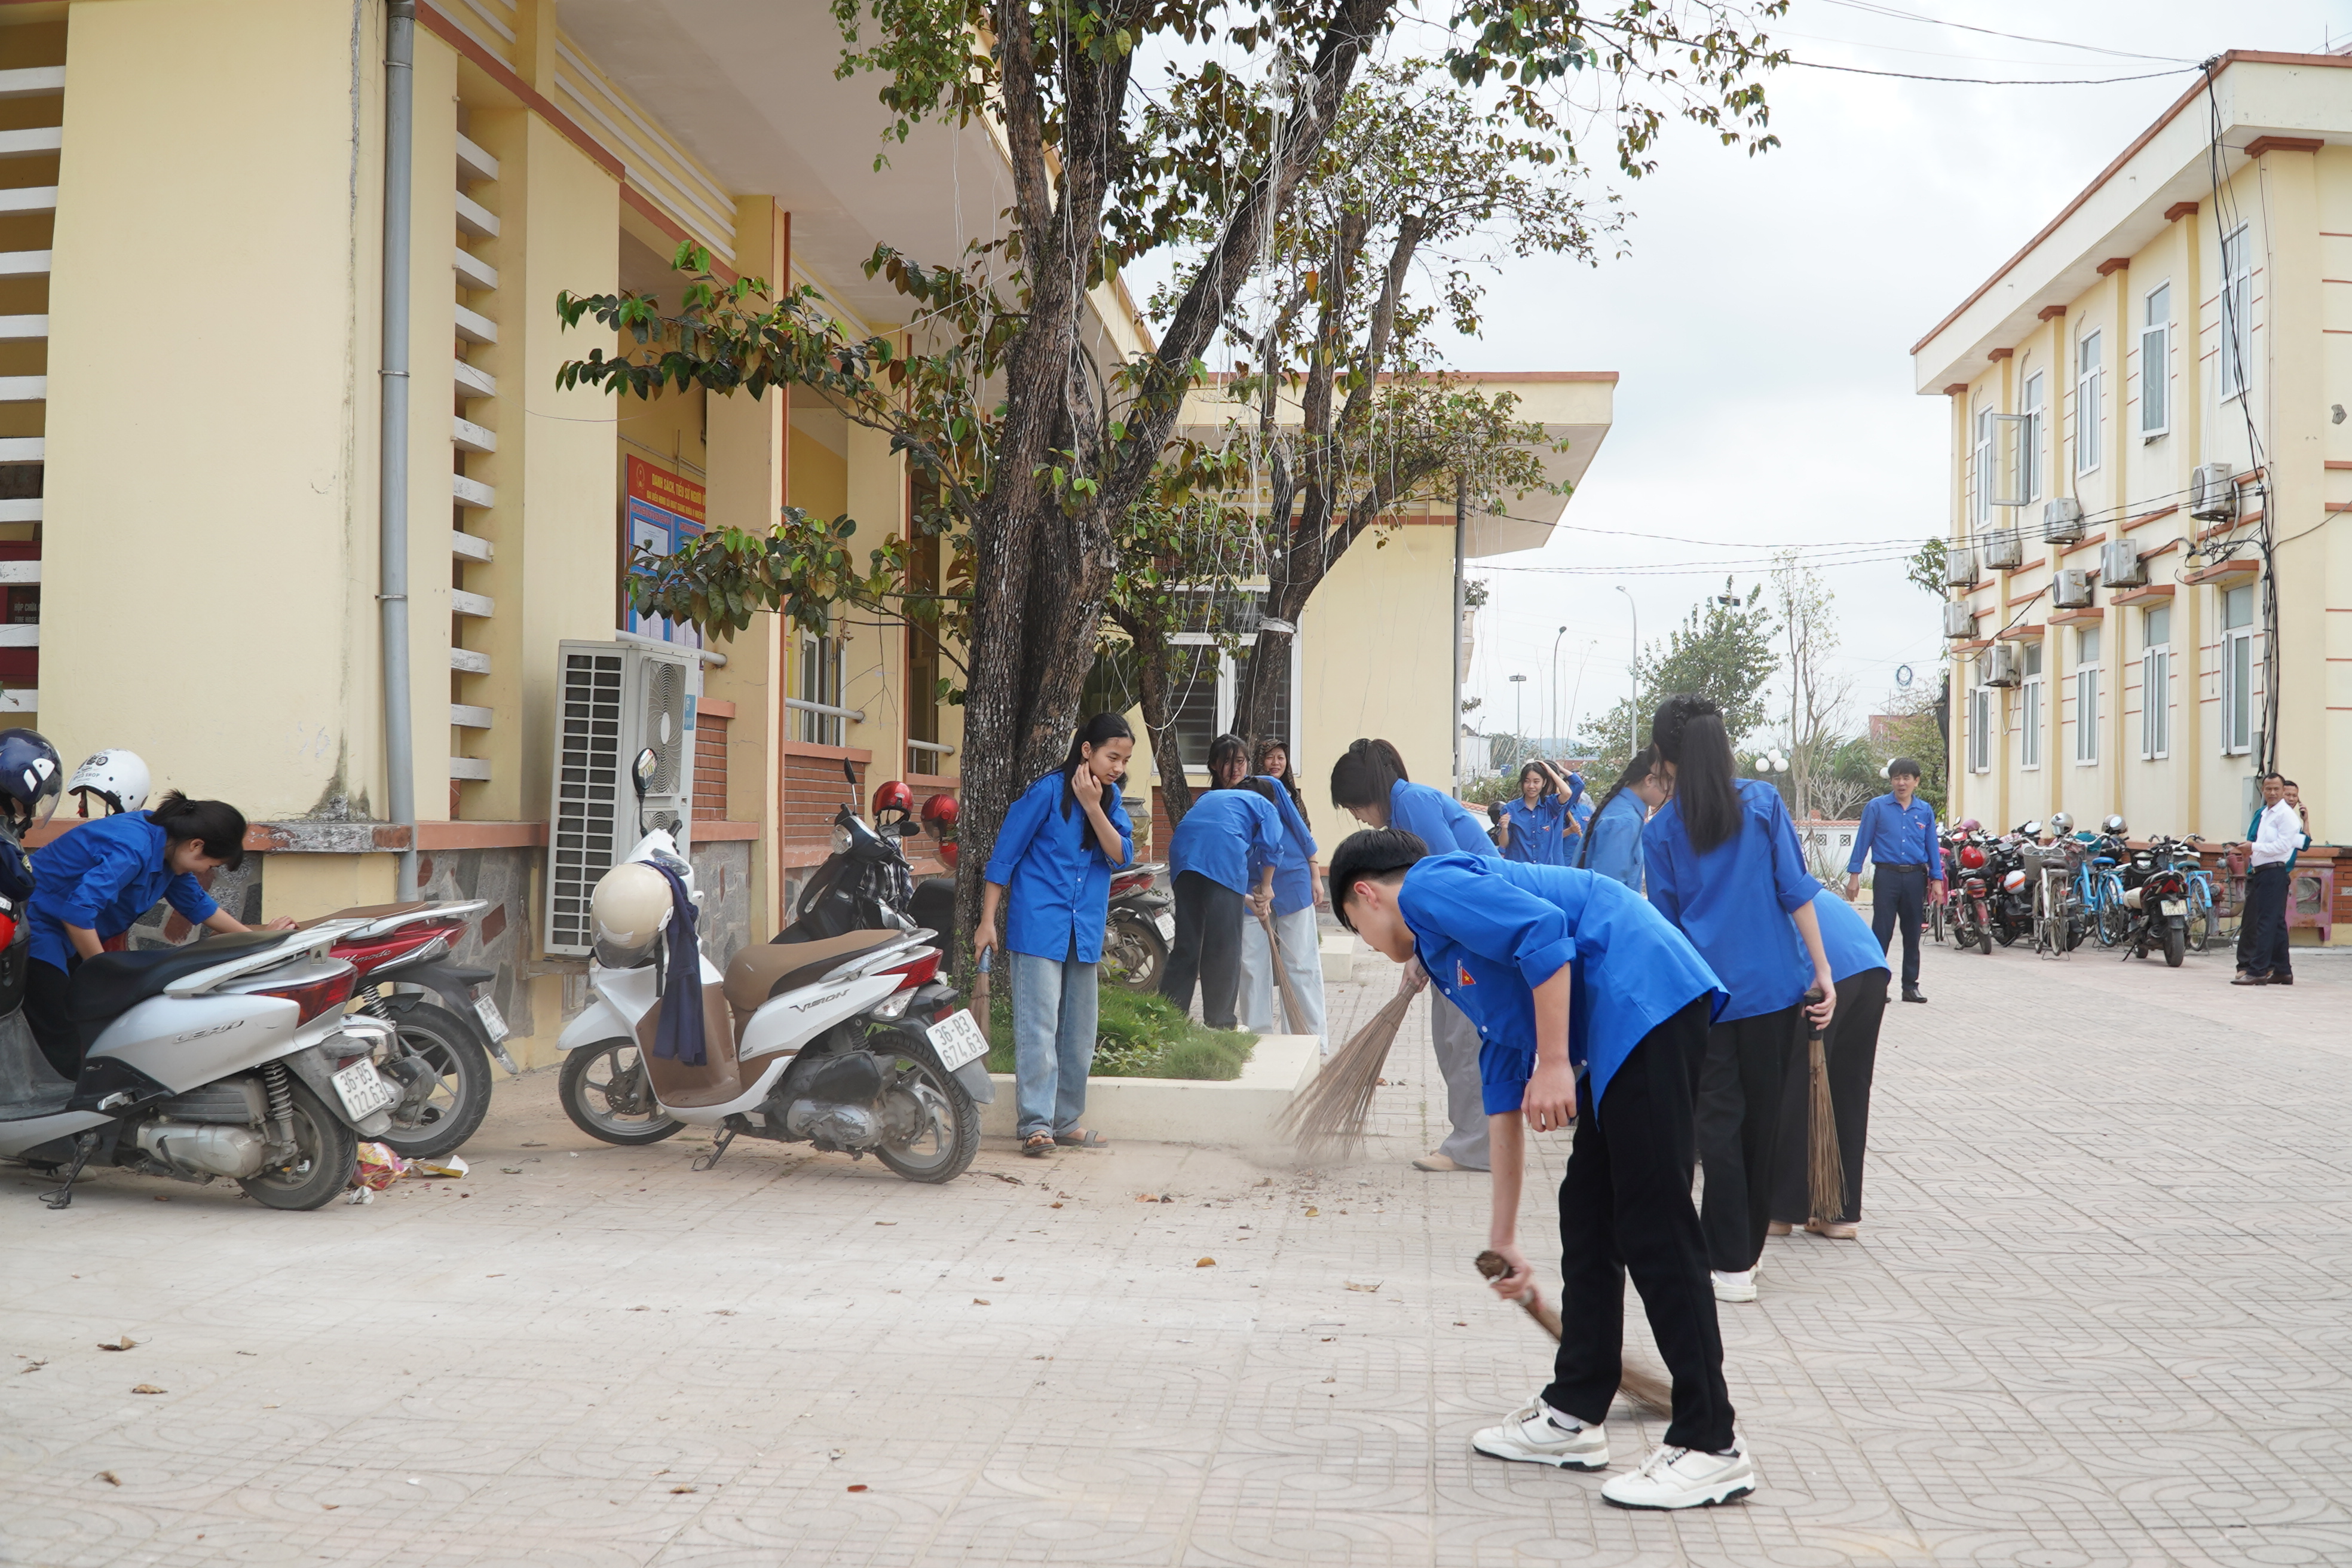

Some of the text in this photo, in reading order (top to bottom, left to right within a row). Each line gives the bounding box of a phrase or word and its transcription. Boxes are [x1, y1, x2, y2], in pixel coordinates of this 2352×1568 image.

[171, 1019, 244, 1045] LEAD
[935, 1015, 970, 1046] 36-B3
[942, 1033, 984, 1067] 674.63
[340, 1062, 372, 1094] 36-B5
[348, 1082, 386, 1116] 122.63
